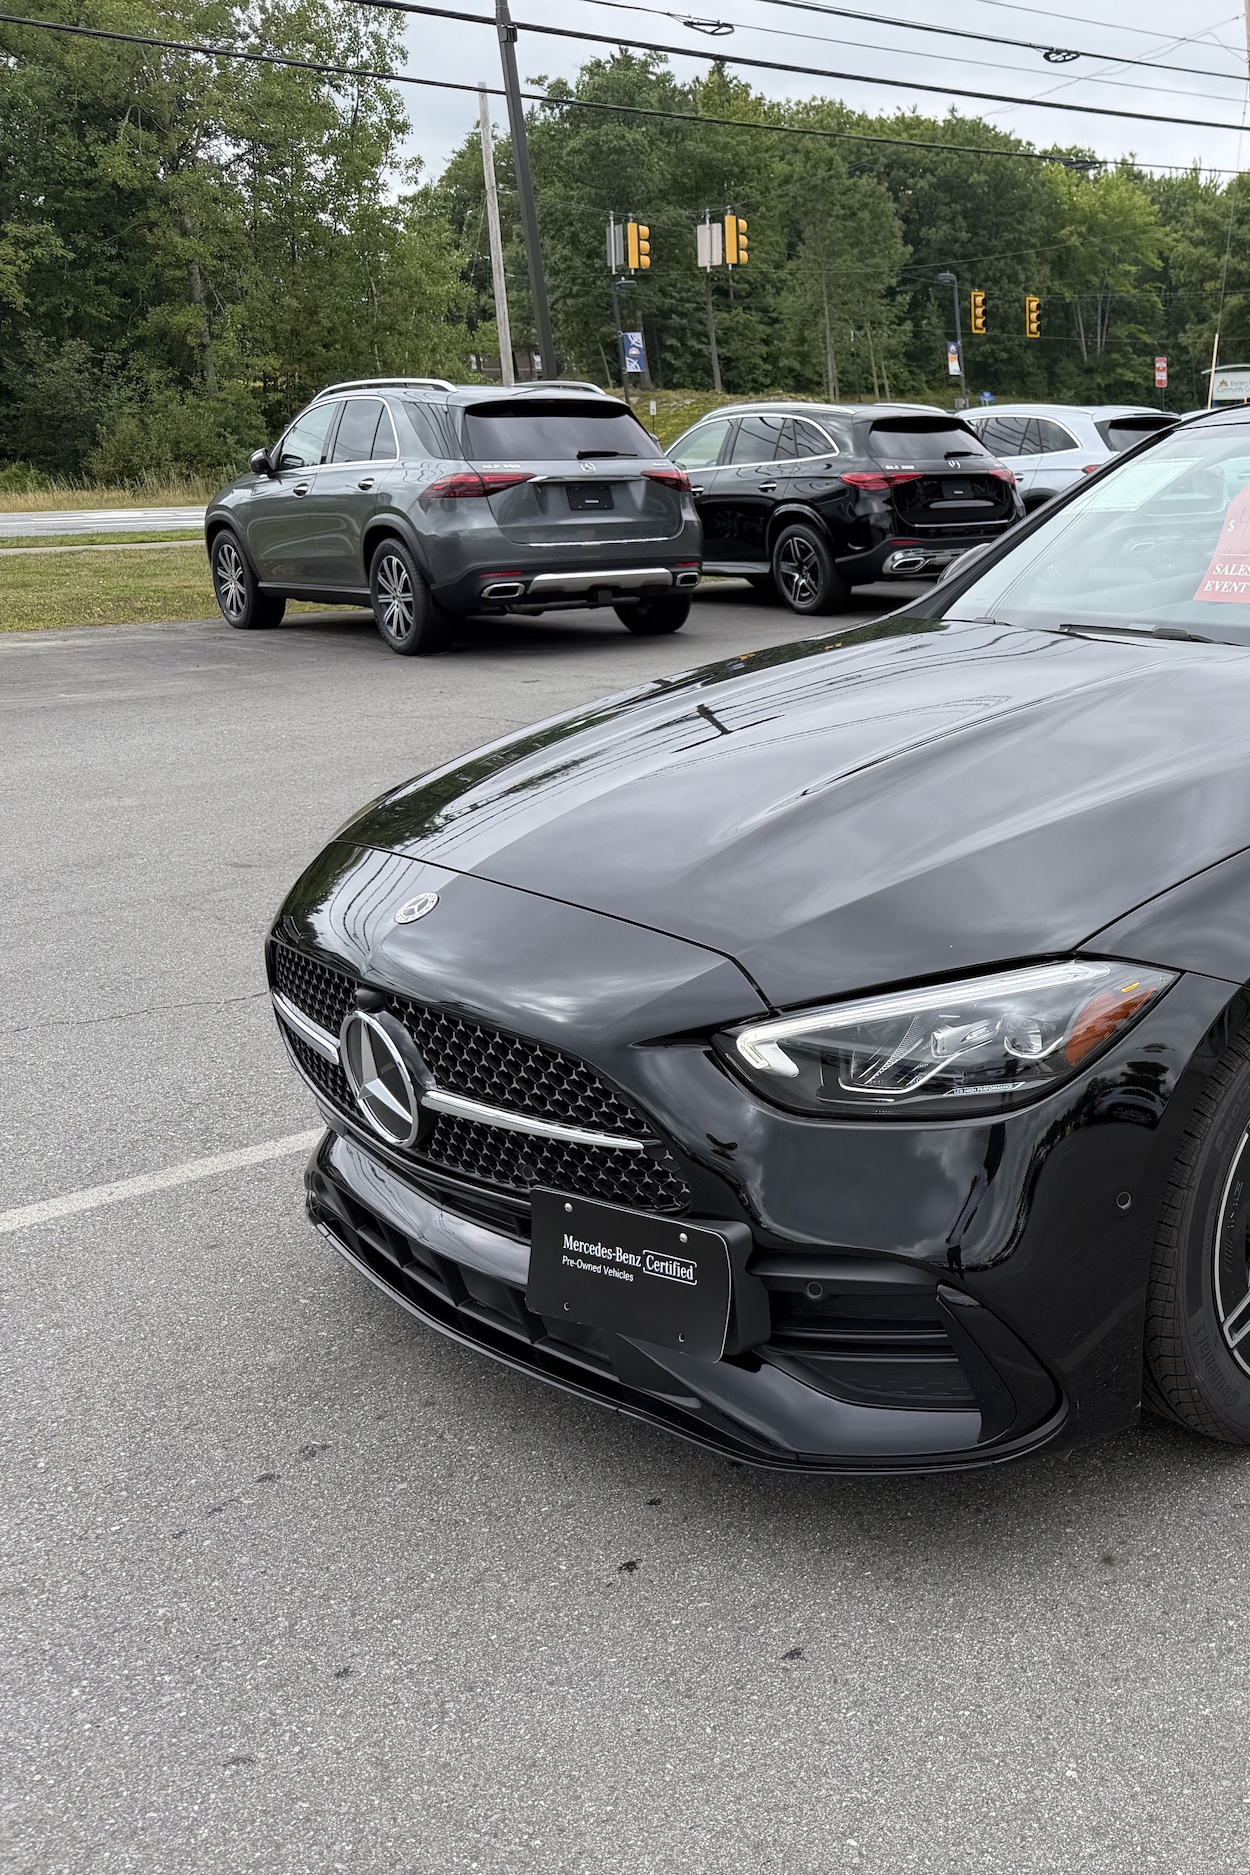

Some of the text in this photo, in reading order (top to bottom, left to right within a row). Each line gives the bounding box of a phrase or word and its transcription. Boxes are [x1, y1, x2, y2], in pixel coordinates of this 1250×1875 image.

[1227, 518, 1236, 533] $
[1203, 580, 1250, 593] EVENT
[562, 1233, 694, 1281] Mercedes-Benz Certified
[562, 1255, 634, 1282] Pre-Owned Vehicles
[1194, 1335, 1241, 1408] Continental
